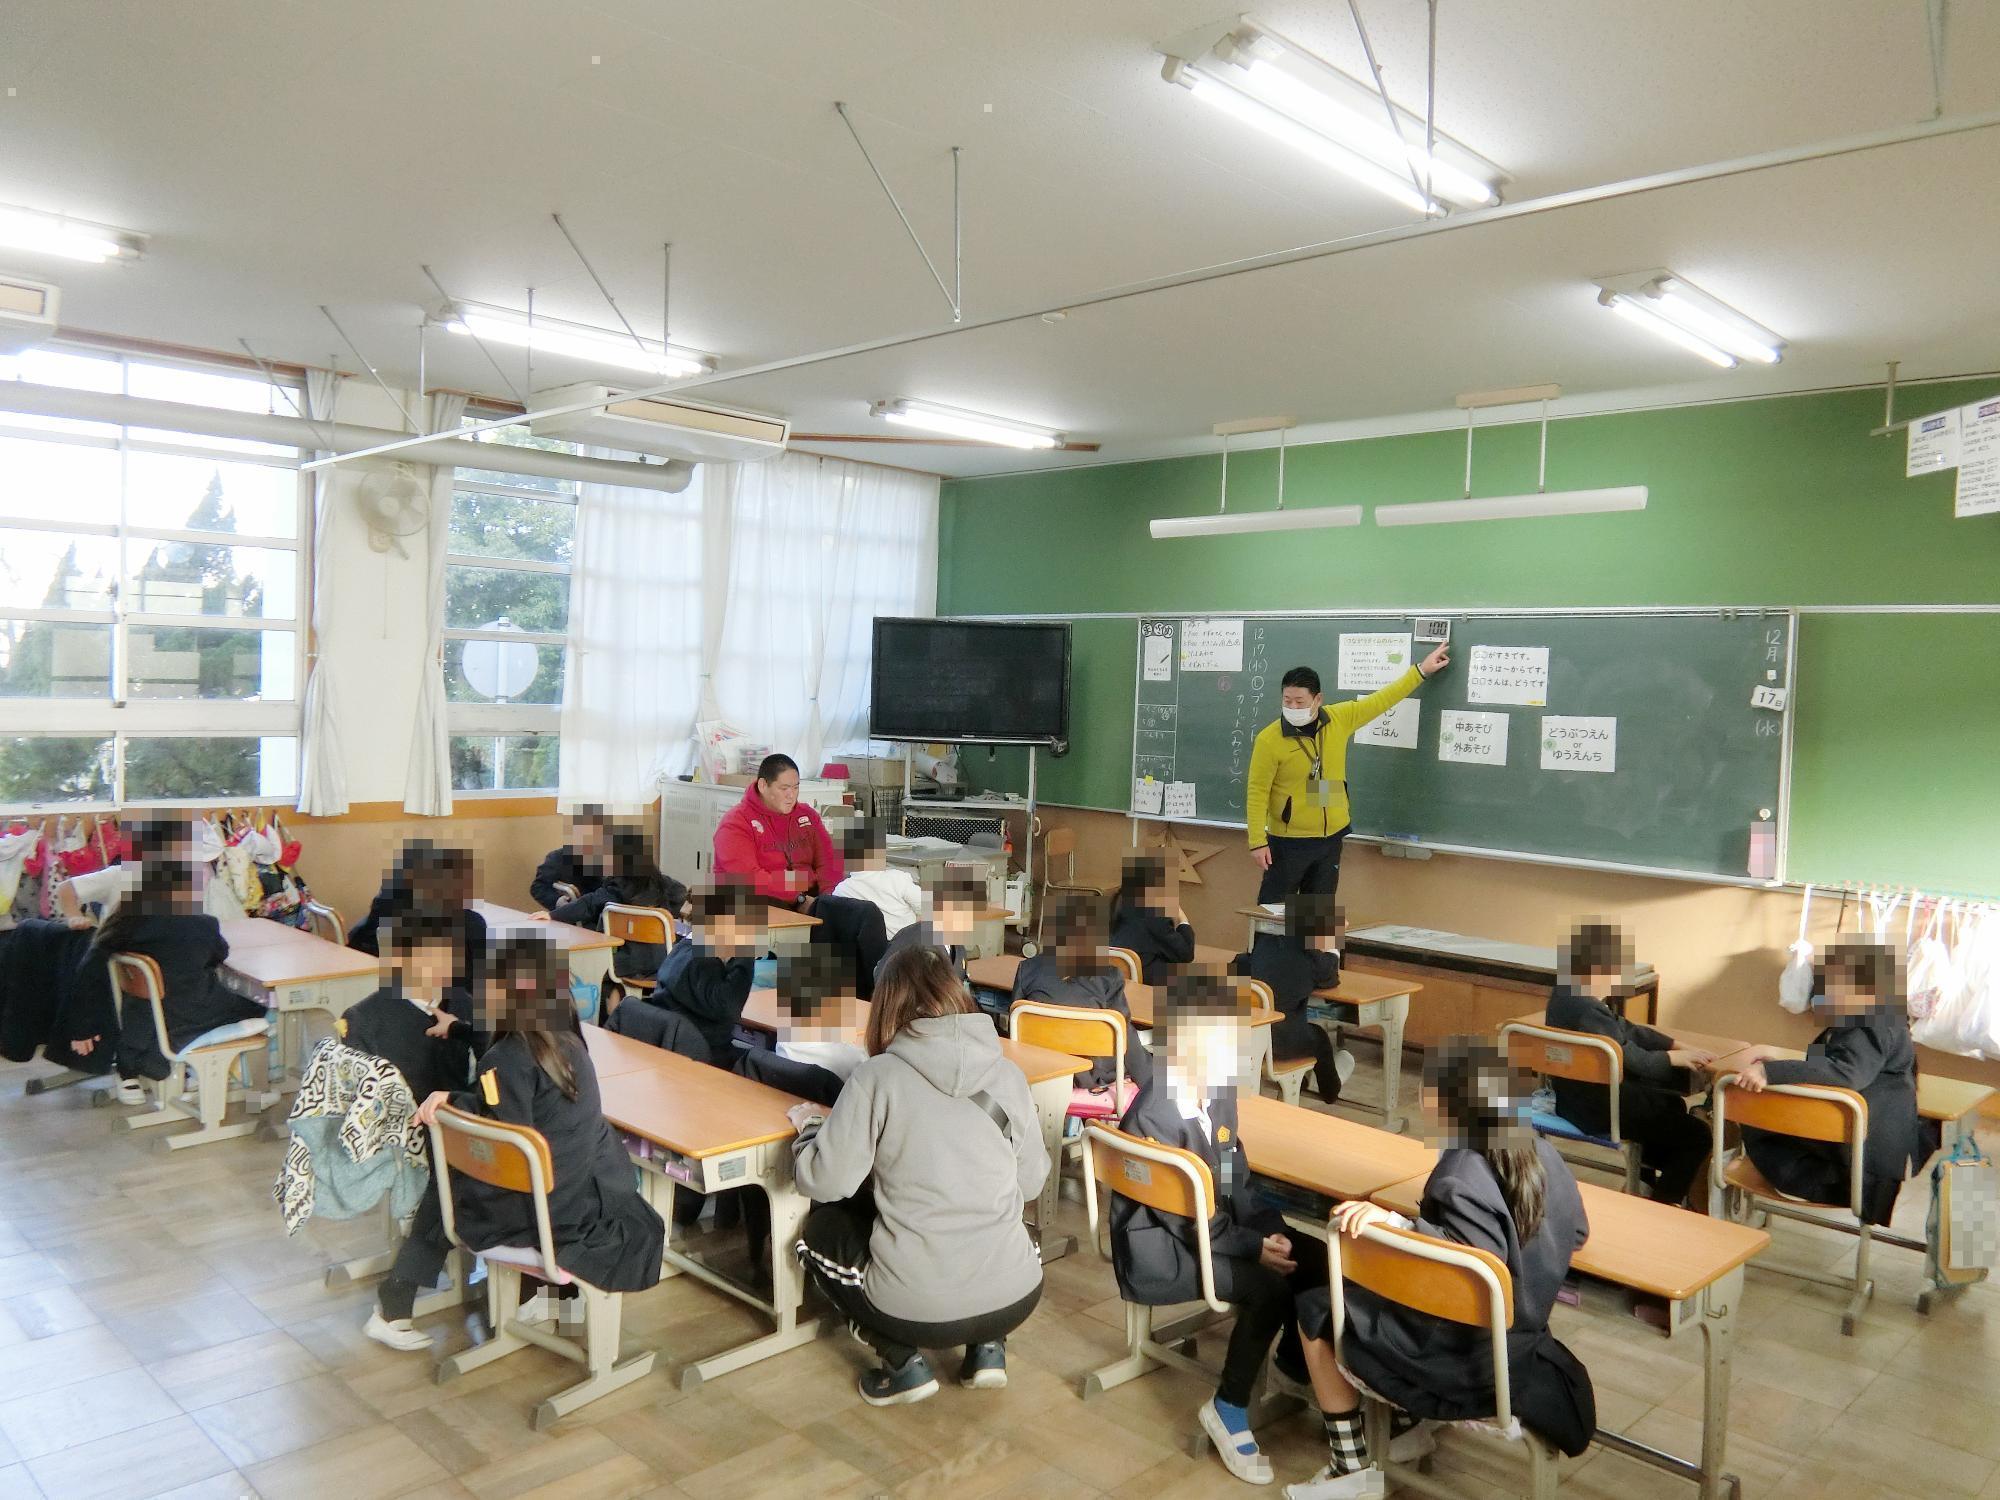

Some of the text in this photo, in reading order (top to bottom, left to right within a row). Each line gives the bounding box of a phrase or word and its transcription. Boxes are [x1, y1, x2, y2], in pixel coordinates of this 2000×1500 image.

[1372, 727, 1399, 738] ごはん
[1455, 721, 1493, 734] 中あそび
[1549, 727, 1609, 740] どうぶつえん
[1454, 742, 1491, 754] 外あそび
[1553, 750, 1602, 762] ゆうえんち
